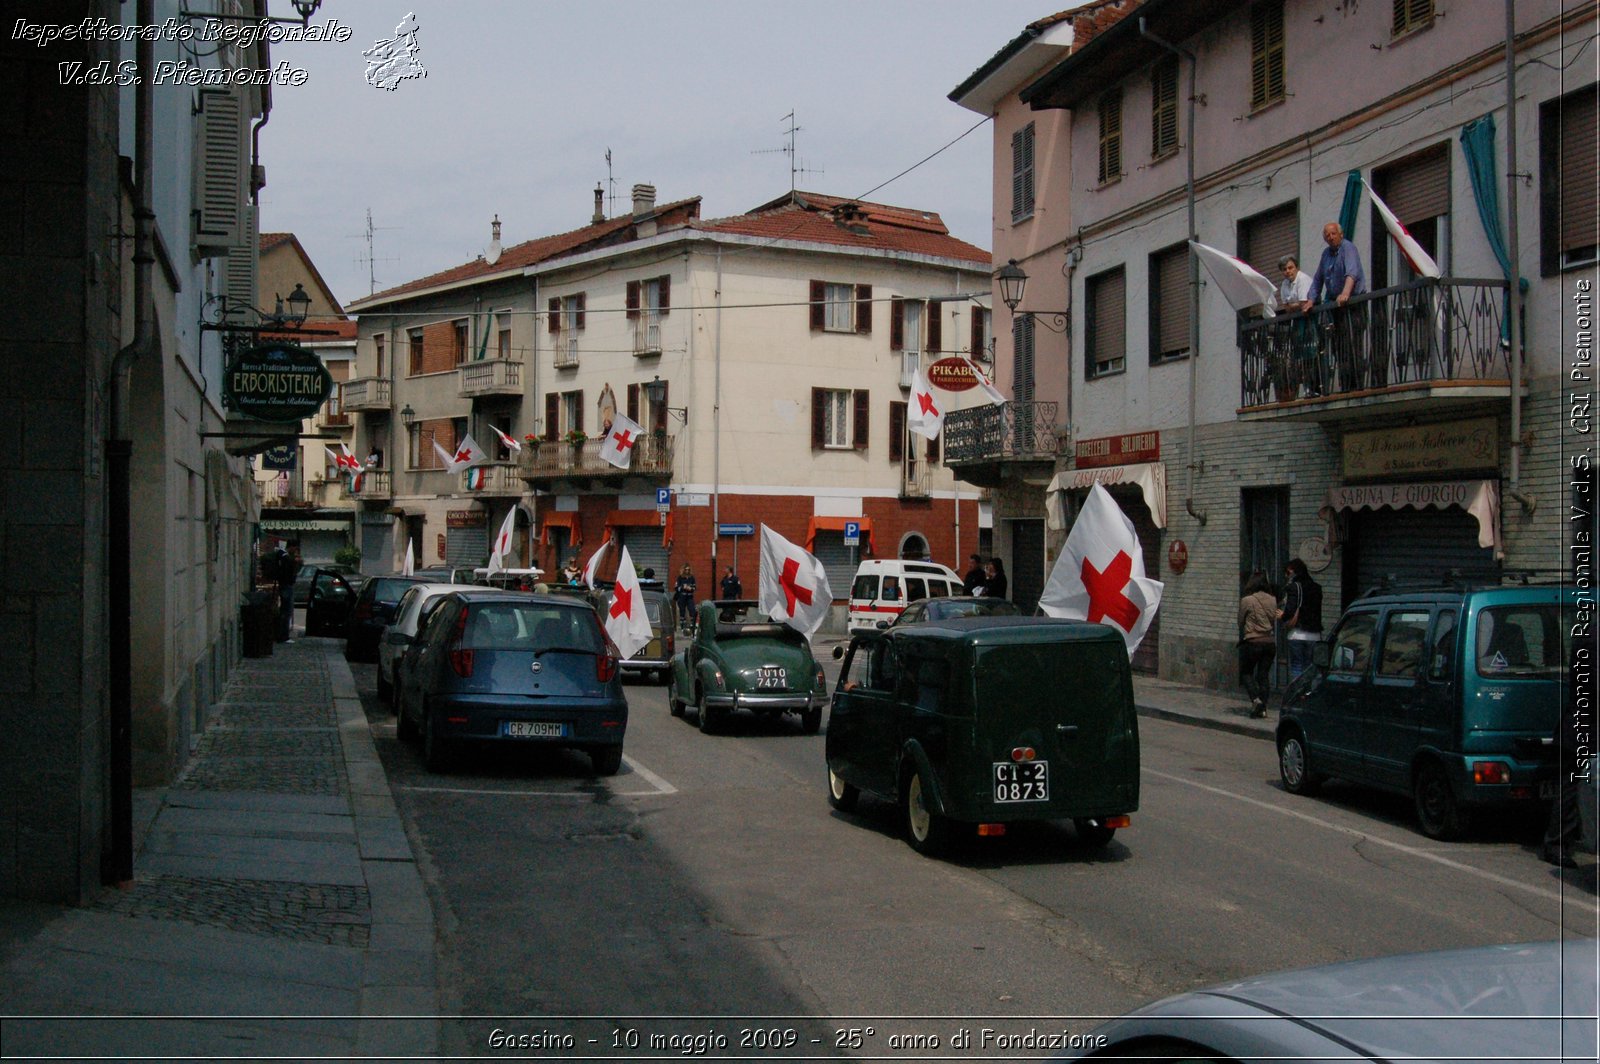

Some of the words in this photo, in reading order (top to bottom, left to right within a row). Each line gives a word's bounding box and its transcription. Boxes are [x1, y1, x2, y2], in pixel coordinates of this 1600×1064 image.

[233, 373, 322, 394] ERBORISTERIA
[659, 489, 668, 502] P
[1341, 487, 1383, 506] SABINA
[1391, 485, 1400, 503] E
[1406, 484, 1467, 503] GIORGIO
[848, 524, 856, 537] P
[757, 678, 786, 688] 7471
[527, 723, 561, 735] 709MM
[996, 782, 1046, 800] 0873
